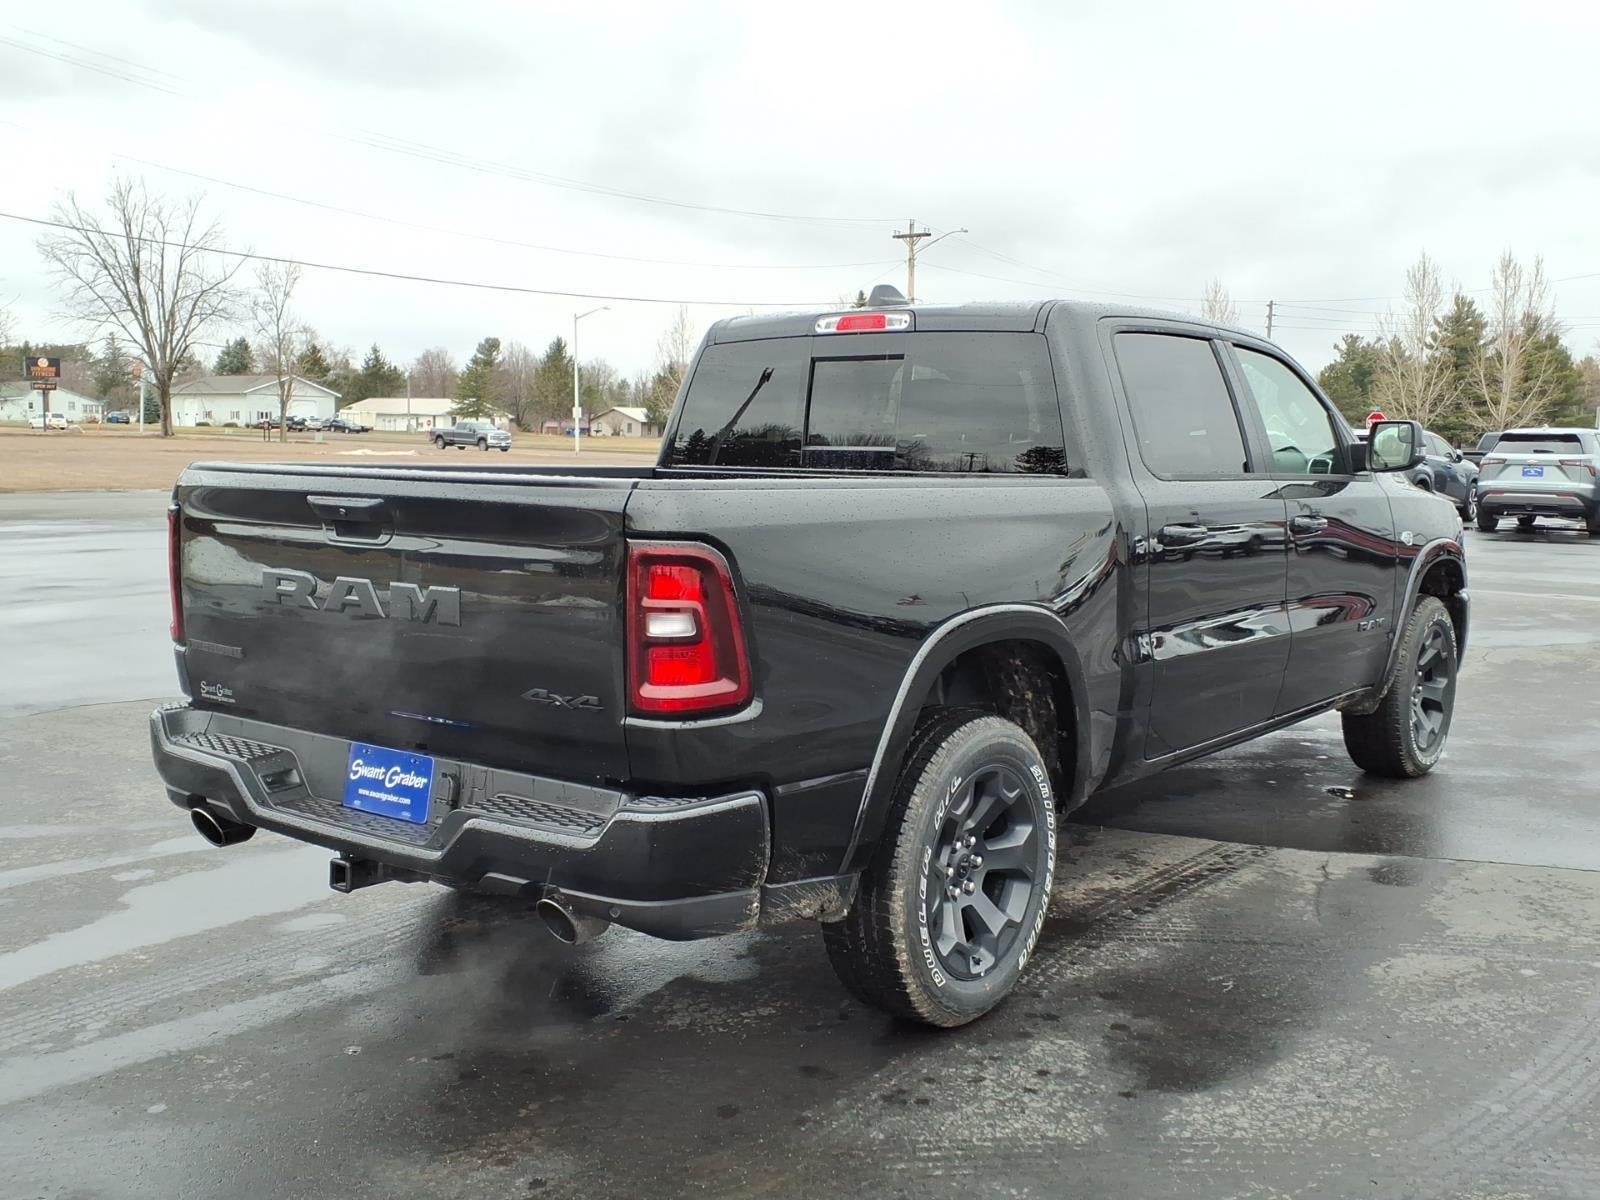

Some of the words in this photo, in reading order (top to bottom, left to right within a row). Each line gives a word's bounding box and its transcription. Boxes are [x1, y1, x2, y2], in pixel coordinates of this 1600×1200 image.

[262, 567, 461, 627] RAM
[350, 759, 386, 780] Swant
[384, 766, 427, 789] Graber
[358, 788, 411, 805] www.swantgraber.com
[919, 845, 946, 988] DUELER
